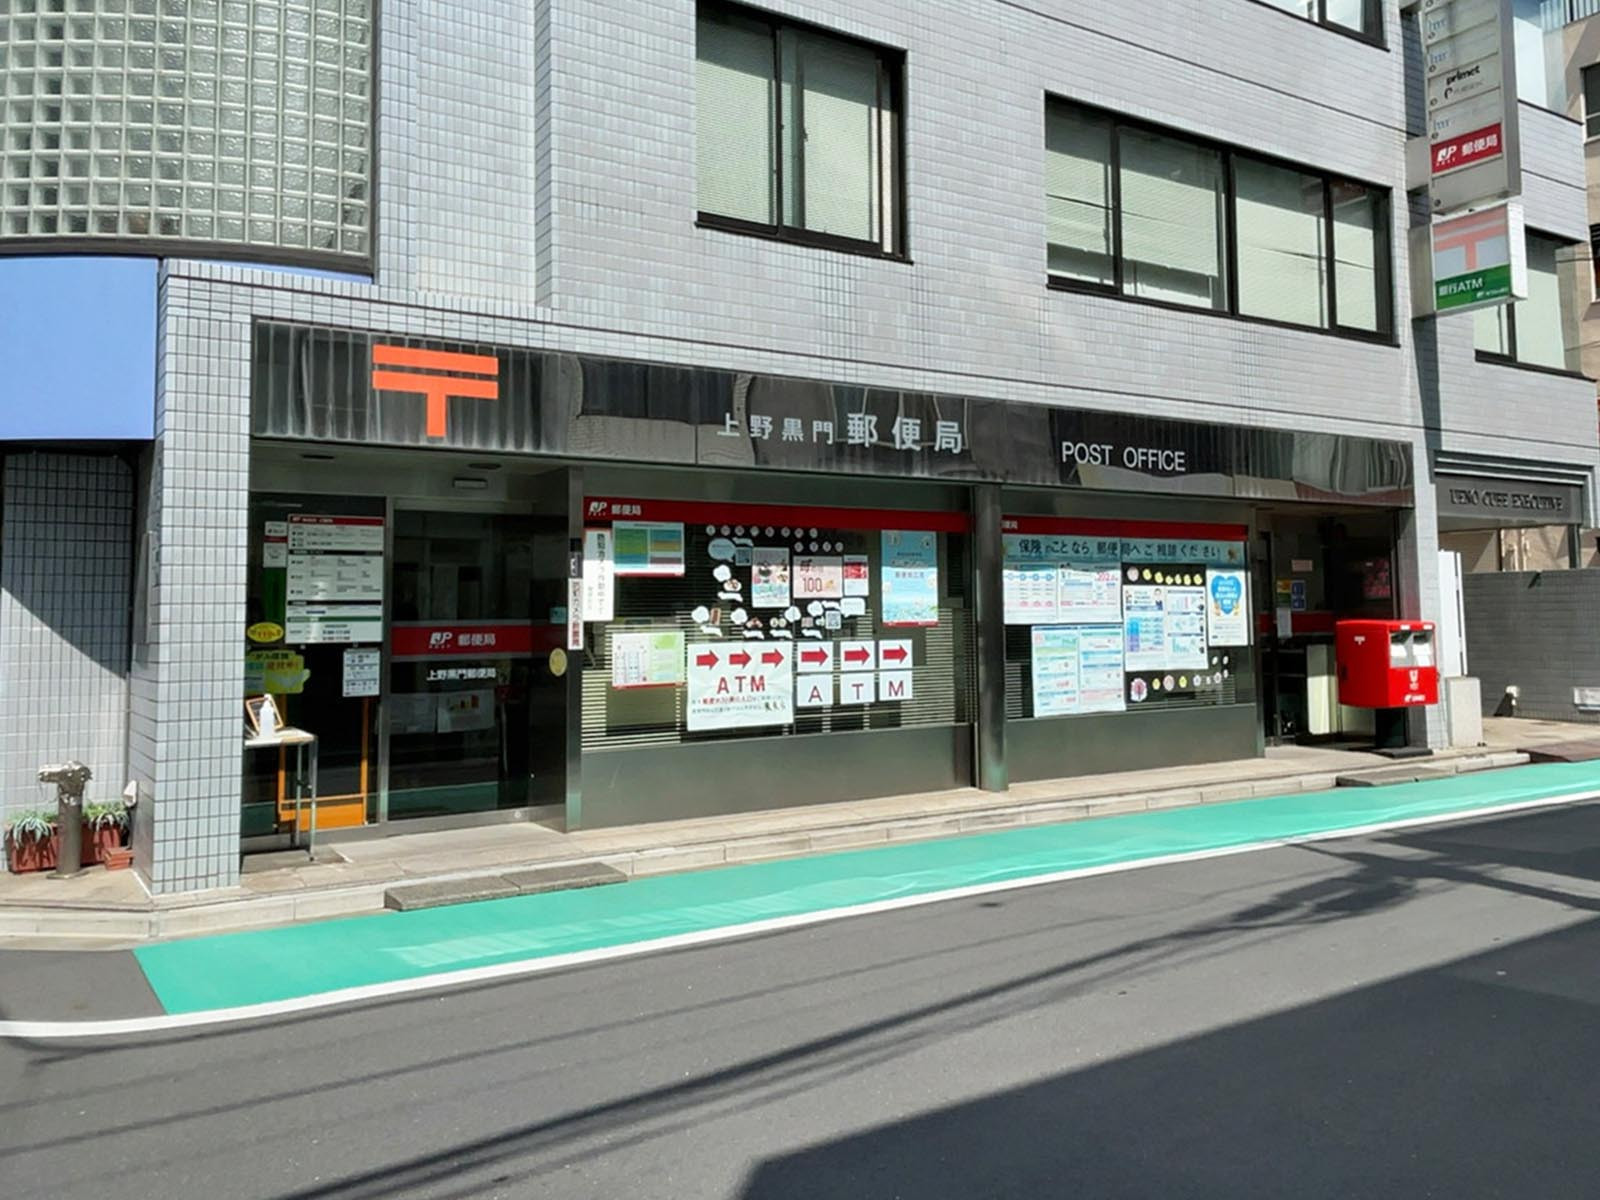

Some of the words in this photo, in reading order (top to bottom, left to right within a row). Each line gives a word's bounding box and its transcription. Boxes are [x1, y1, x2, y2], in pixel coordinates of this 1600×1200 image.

[1461, 134, 1498, 157] 郵便局
[716, 412, 963, 454] 上野黒門郵便局
[1061, 441, 1113, 466] POST
[1123, 446, 1186, 472] OFFICE
[611, 504, 641, 516] 郵便局
[802, 577, 823, 592] 100
[458, 633, 496, 647] 郵便局
[717, 675, 765, 694] ATM
